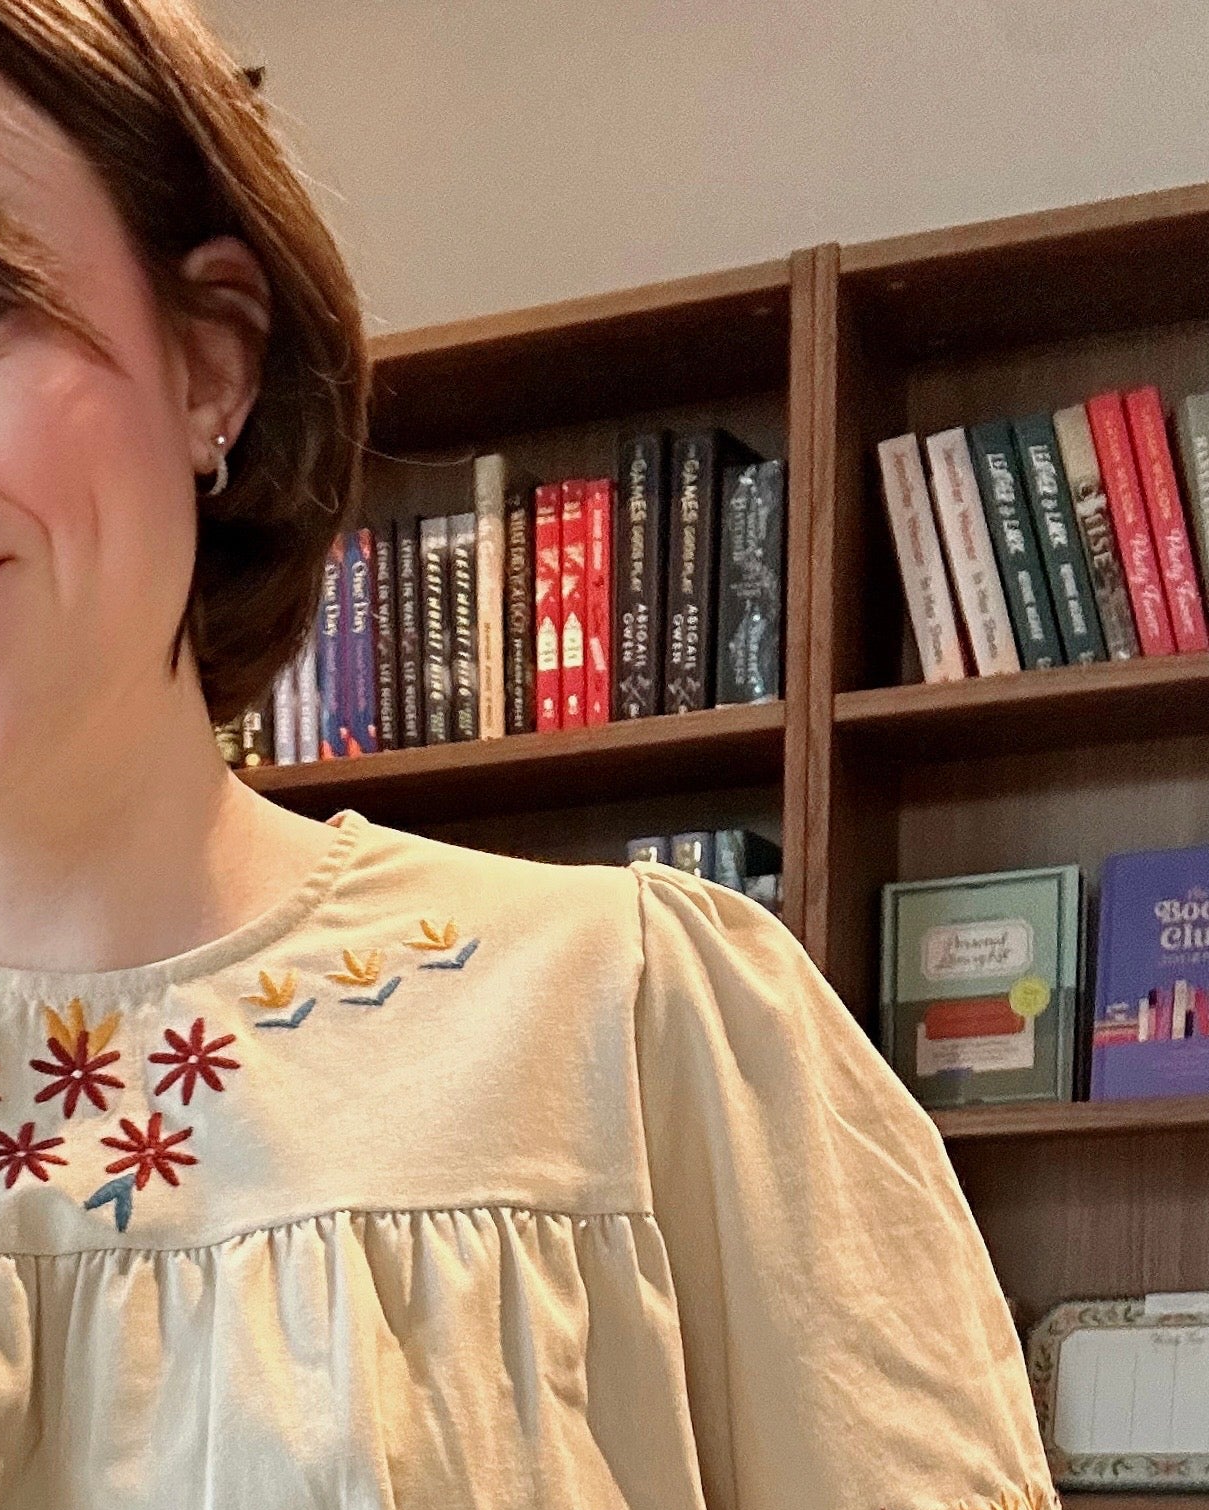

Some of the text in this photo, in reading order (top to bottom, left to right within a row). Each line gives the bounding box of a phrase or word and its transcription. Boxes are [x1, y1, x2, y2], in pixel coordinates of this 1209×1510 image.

[629, 459, 647, 522] GAMES
[680, 458, 700, 523] GAMES
[426, 552, 441, 592] BEST
[375, 541, 392, 739] LYING IN WAIT LIZ NUGENT
[400, 539, 416, 737] LYING IN WAIT LIZ NUGENT
[427, 596, 442, 648] WORST
[454, 547, 473, 696] BEST WORST THING
[634, 603, 648, 666] ABIGAIL
[684, 603, 699, 669] ABIGAIL
[428, 654, 444, 700] THING
